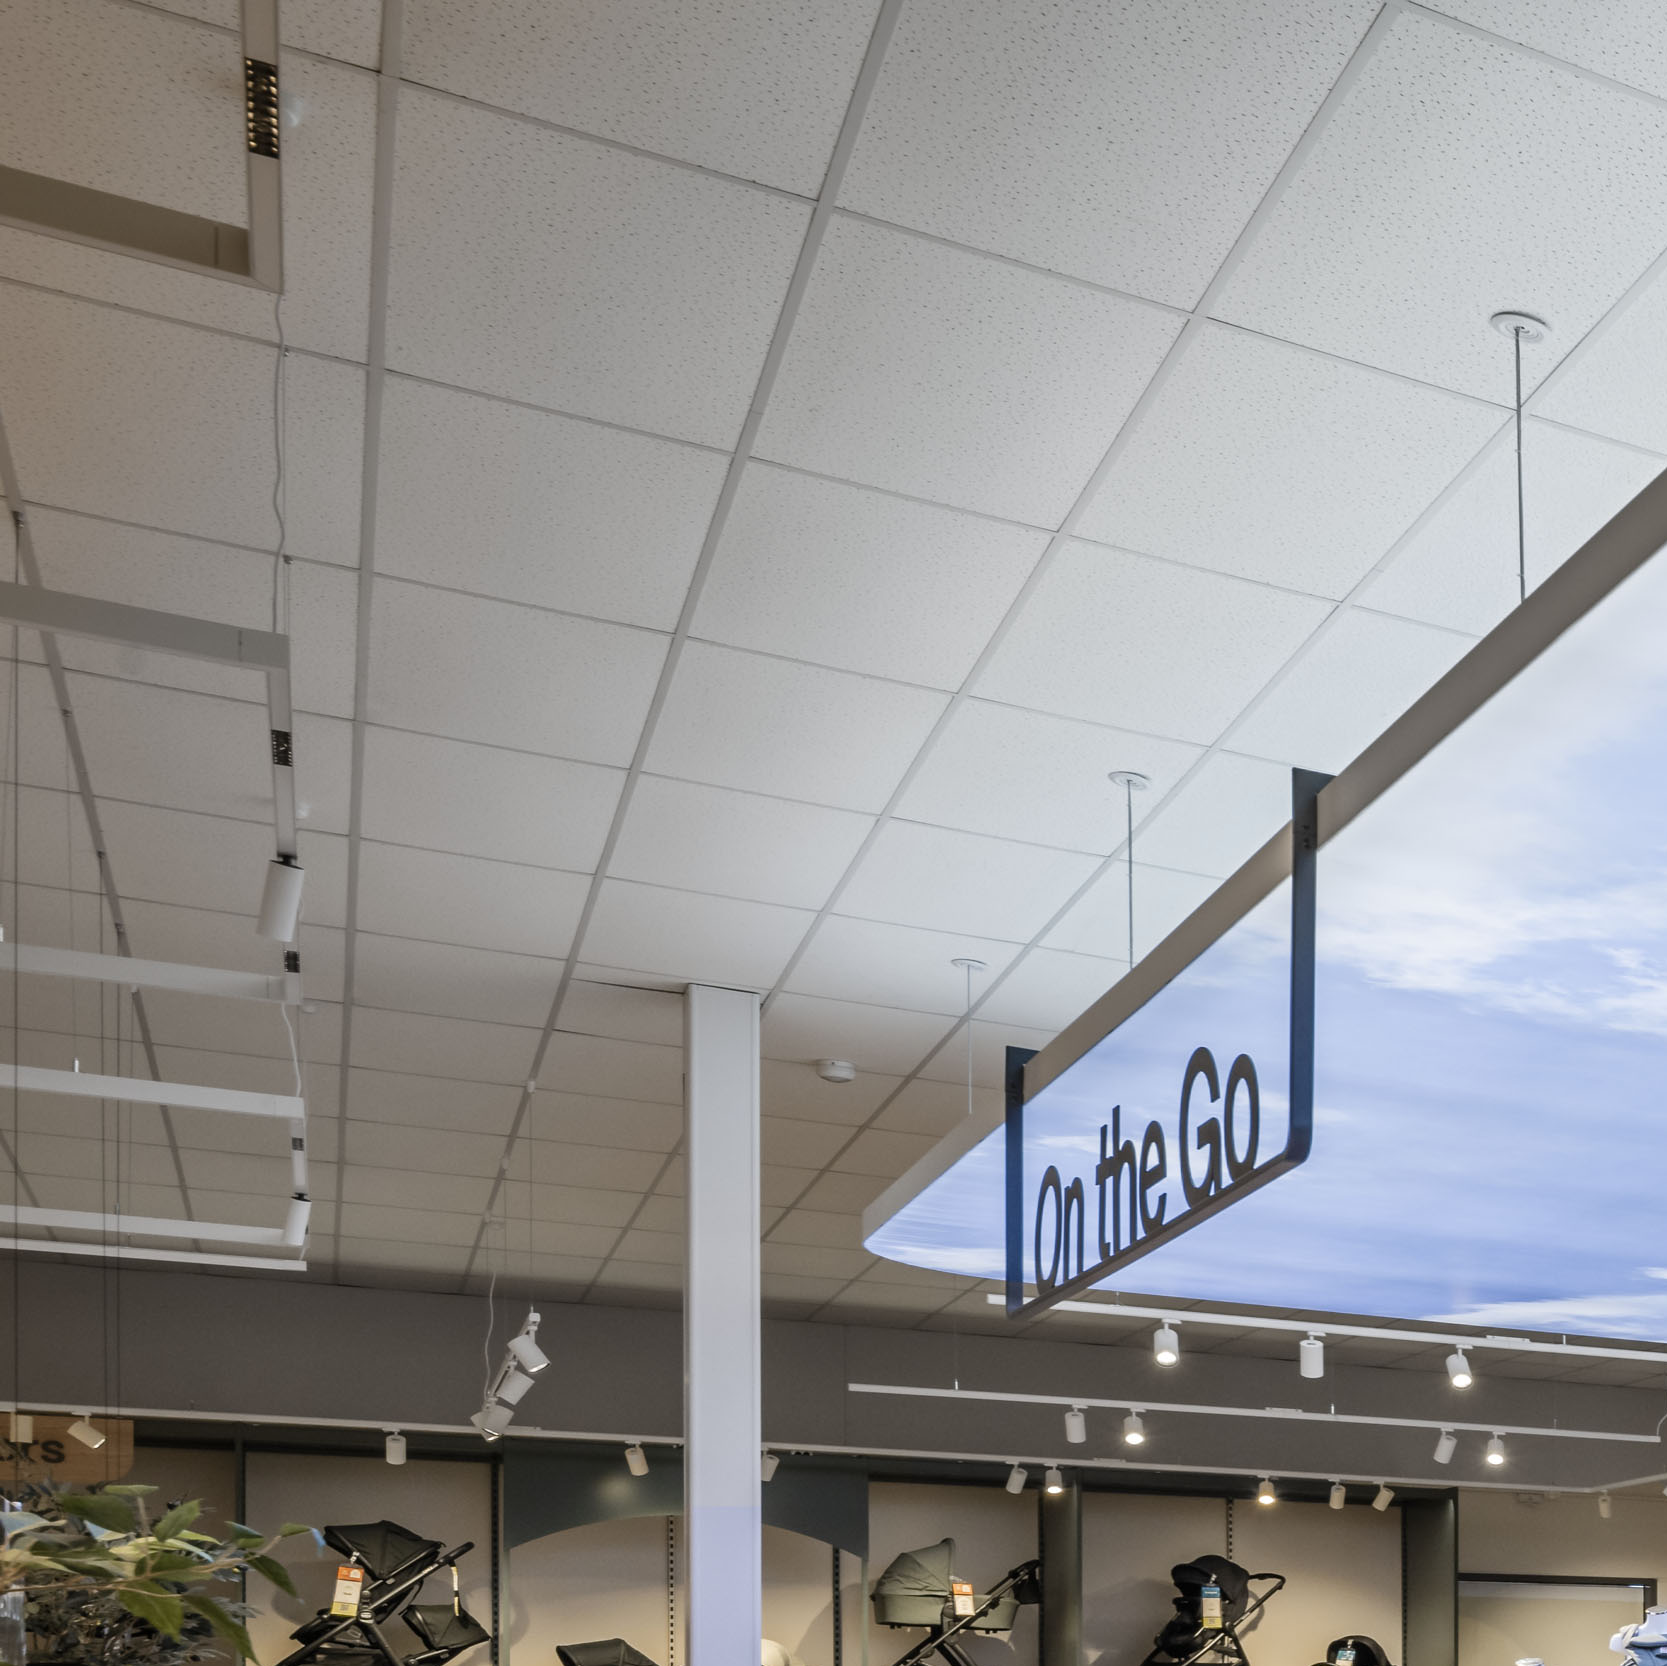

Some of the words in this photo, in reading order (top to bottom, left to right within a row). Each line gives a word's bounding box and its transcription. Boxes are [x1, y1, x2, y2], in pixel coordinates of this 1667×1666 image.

[1035, 1165, 1084, 1296] On
[1095, 1105, 1167, 1262] the
[1180, 1046, 1260, 1209] Go
